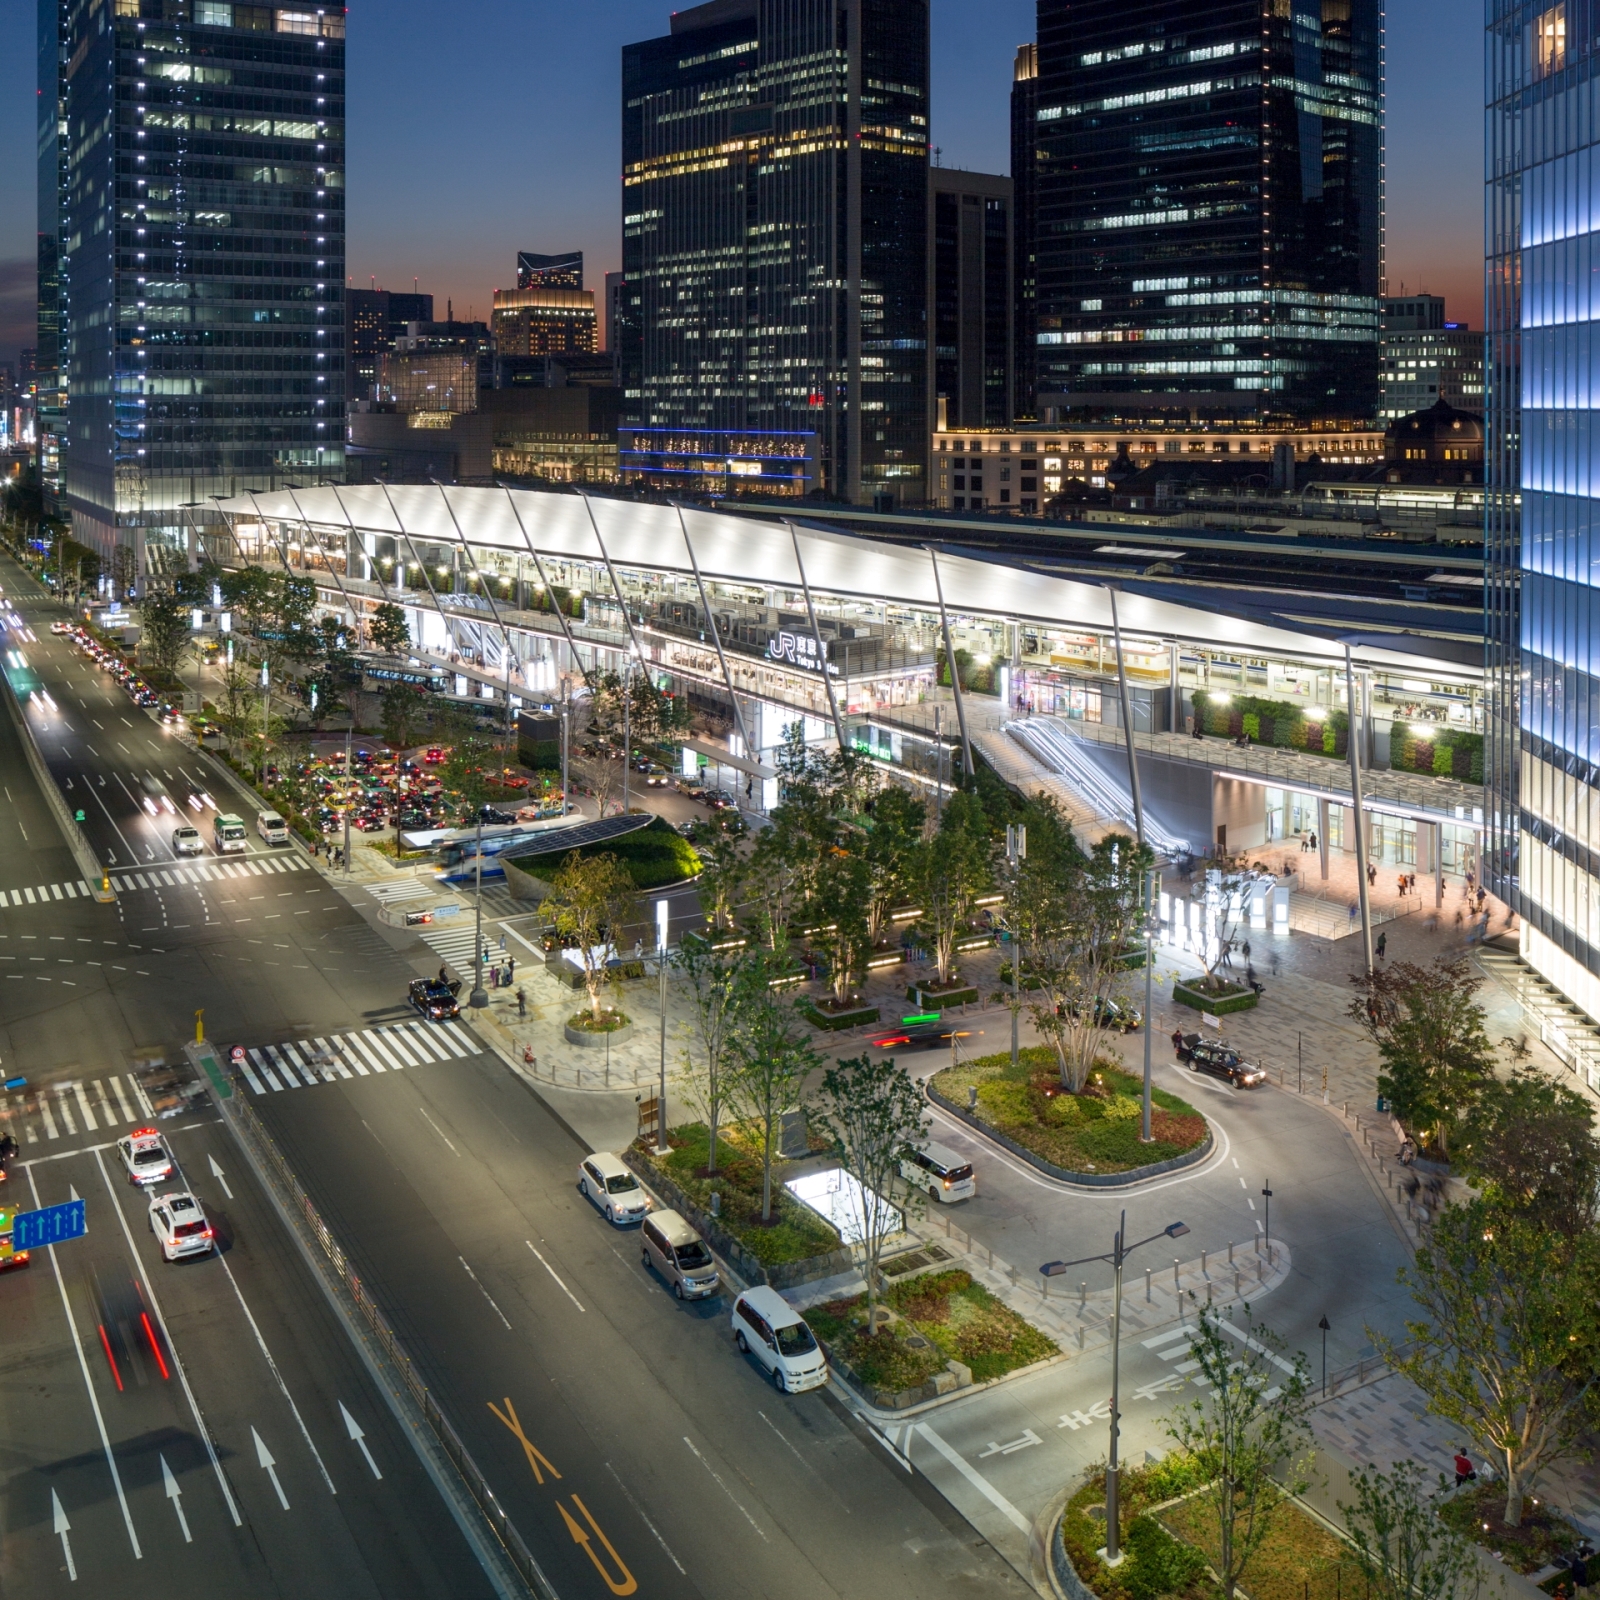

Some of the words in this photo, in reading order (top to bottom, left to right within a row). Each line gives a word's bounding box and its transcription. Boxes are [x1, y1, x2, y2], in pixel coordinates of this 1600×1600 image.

[770, 631, 796, 662] JR
[796, 654, 815, 669] Tokyo
[816, 660, 839, 675] Stion
